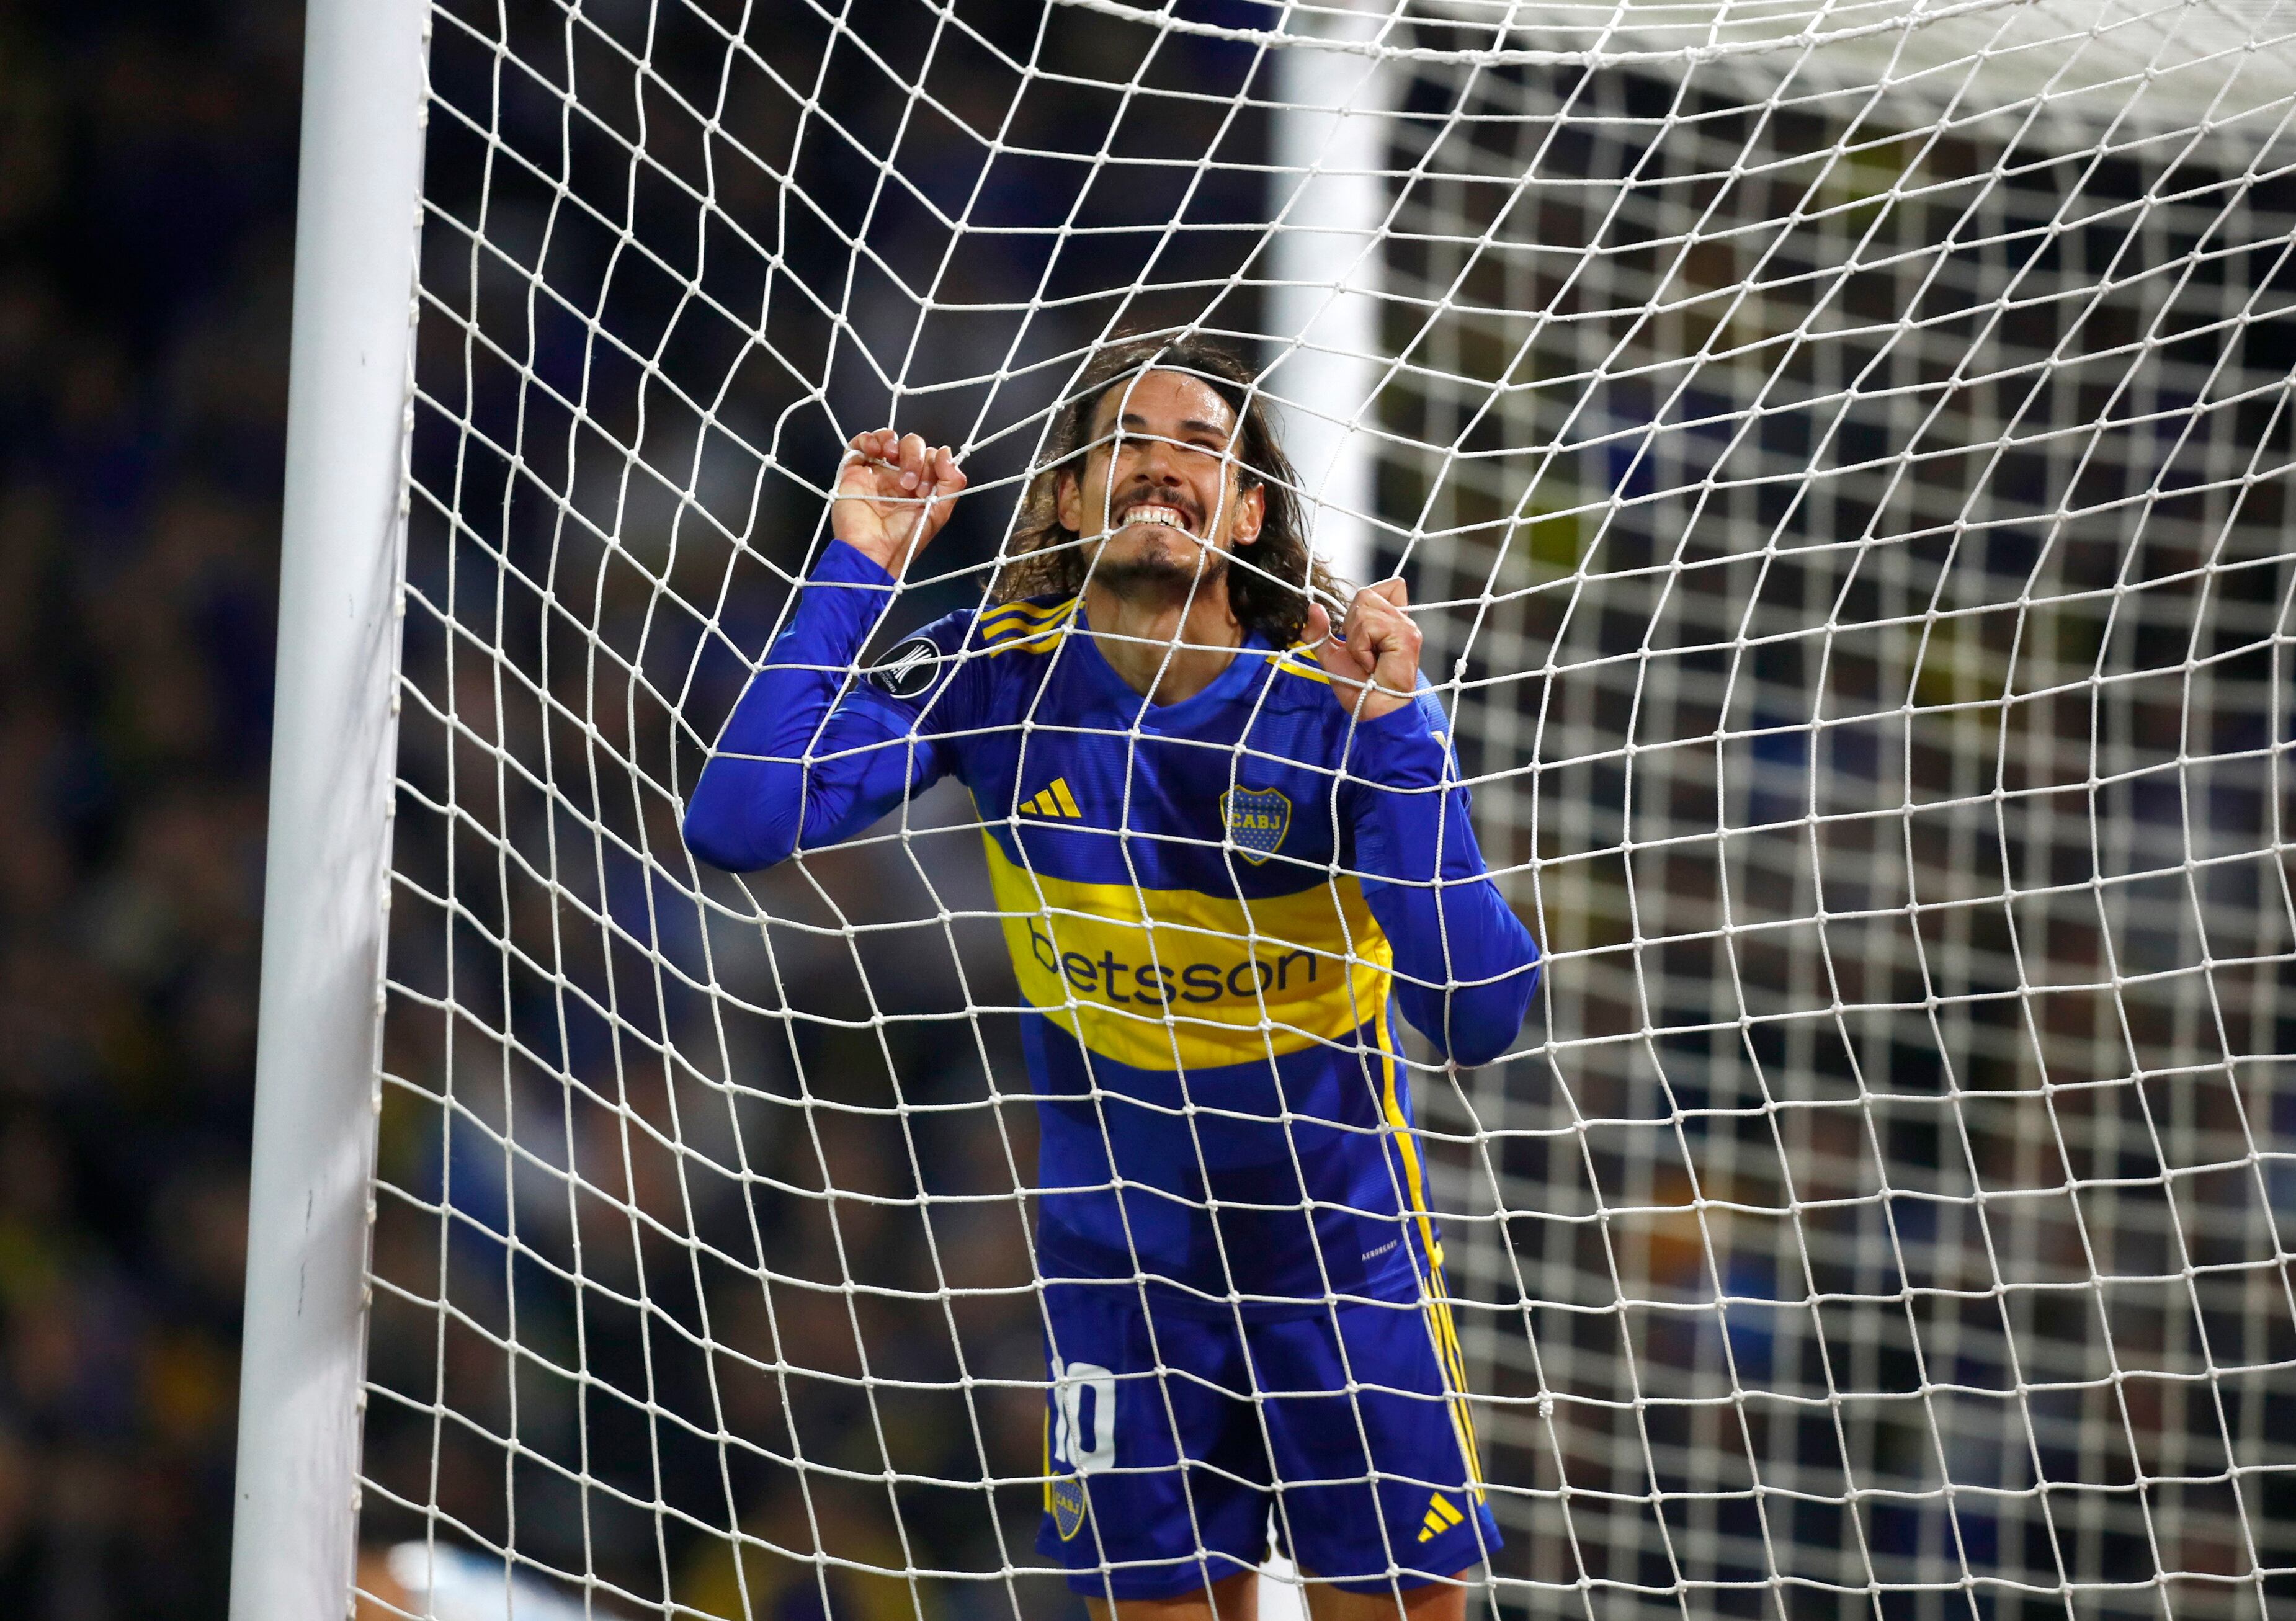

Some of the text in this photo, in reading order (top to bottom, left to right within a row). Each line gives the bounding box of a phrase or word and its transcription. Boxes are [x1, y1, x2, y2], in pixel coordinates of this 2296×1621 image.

[1231, 813, 1281, 829] CABJ
[1026, 916, 1316, 1005] betsson
[1052, 1357, 1115, 1471] 10
